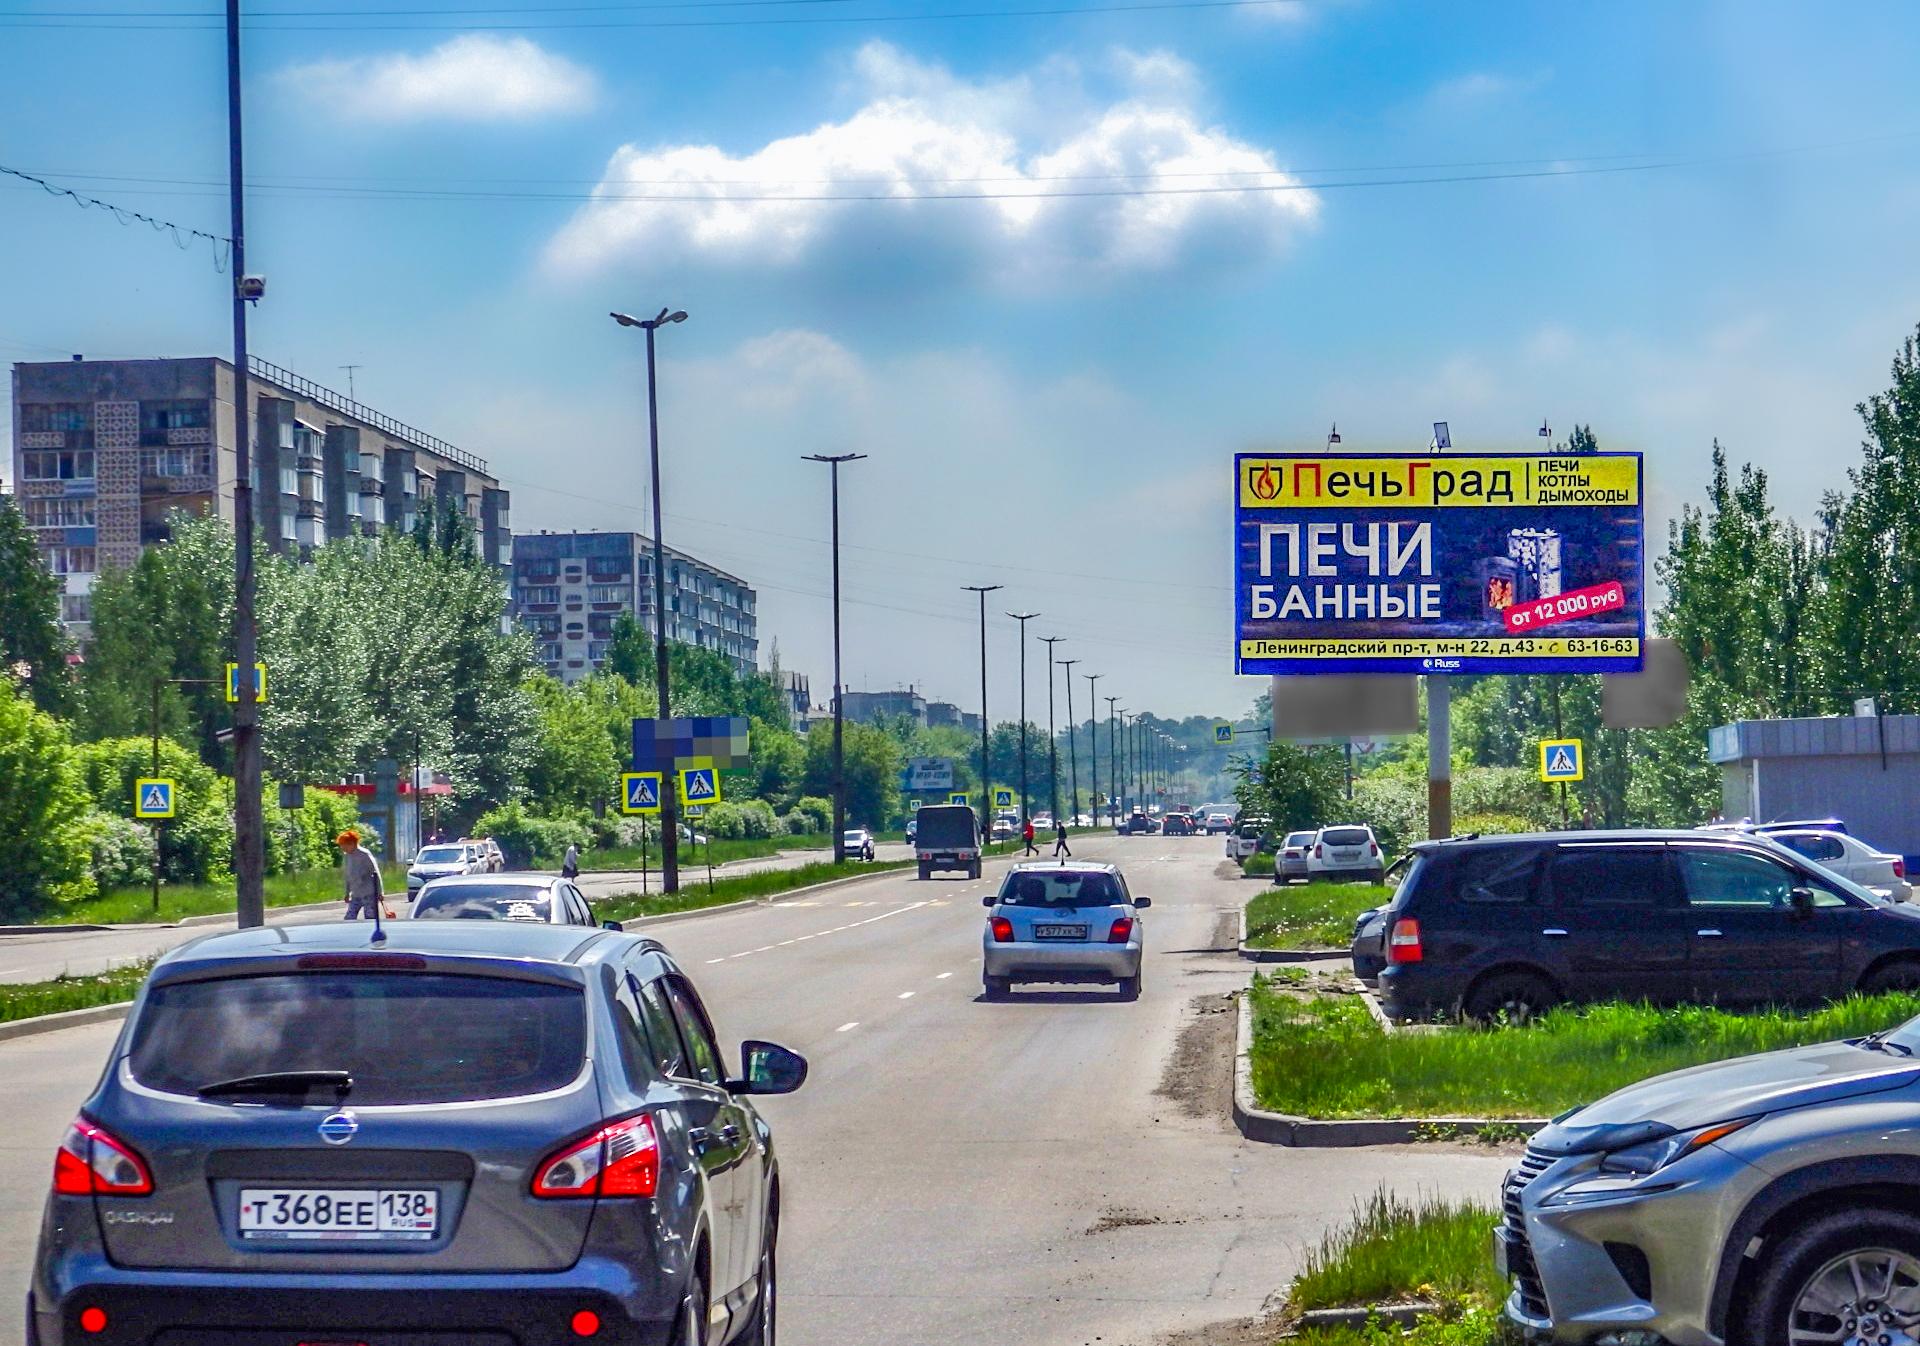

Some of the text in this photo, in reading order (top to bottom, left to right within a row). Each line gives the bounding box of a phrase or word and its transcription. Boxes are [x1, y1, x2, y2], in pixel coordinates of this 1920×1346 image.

[1538, 460, 1580, 472] ПЕЧИ
[1293, 463, 1514, 505] ПечьГрад
[1538, 475, 1590, 487] КОТЛЫ
[1537, 489, 1629, 504] ДЫМОХОДЫ
[1260, 522, 1432, 576] ПЕЧИ
[1251, 584, 1441, 618] БАННЫЕ
[1511, 589, 1618, 625] от 12 000 руб
[1255, 641, 1387, 656] Ленинградский
[1436, 643, 1465, 653] м-н
[1470, 640, 1494, 654] 22,
[1499, 640, 1535, 654] д.43
[1567, 640, 1633, 653] 63-16-63
[1434, 658, 1461, 668] Russ
[382, 1193, 427, 1217] 138
